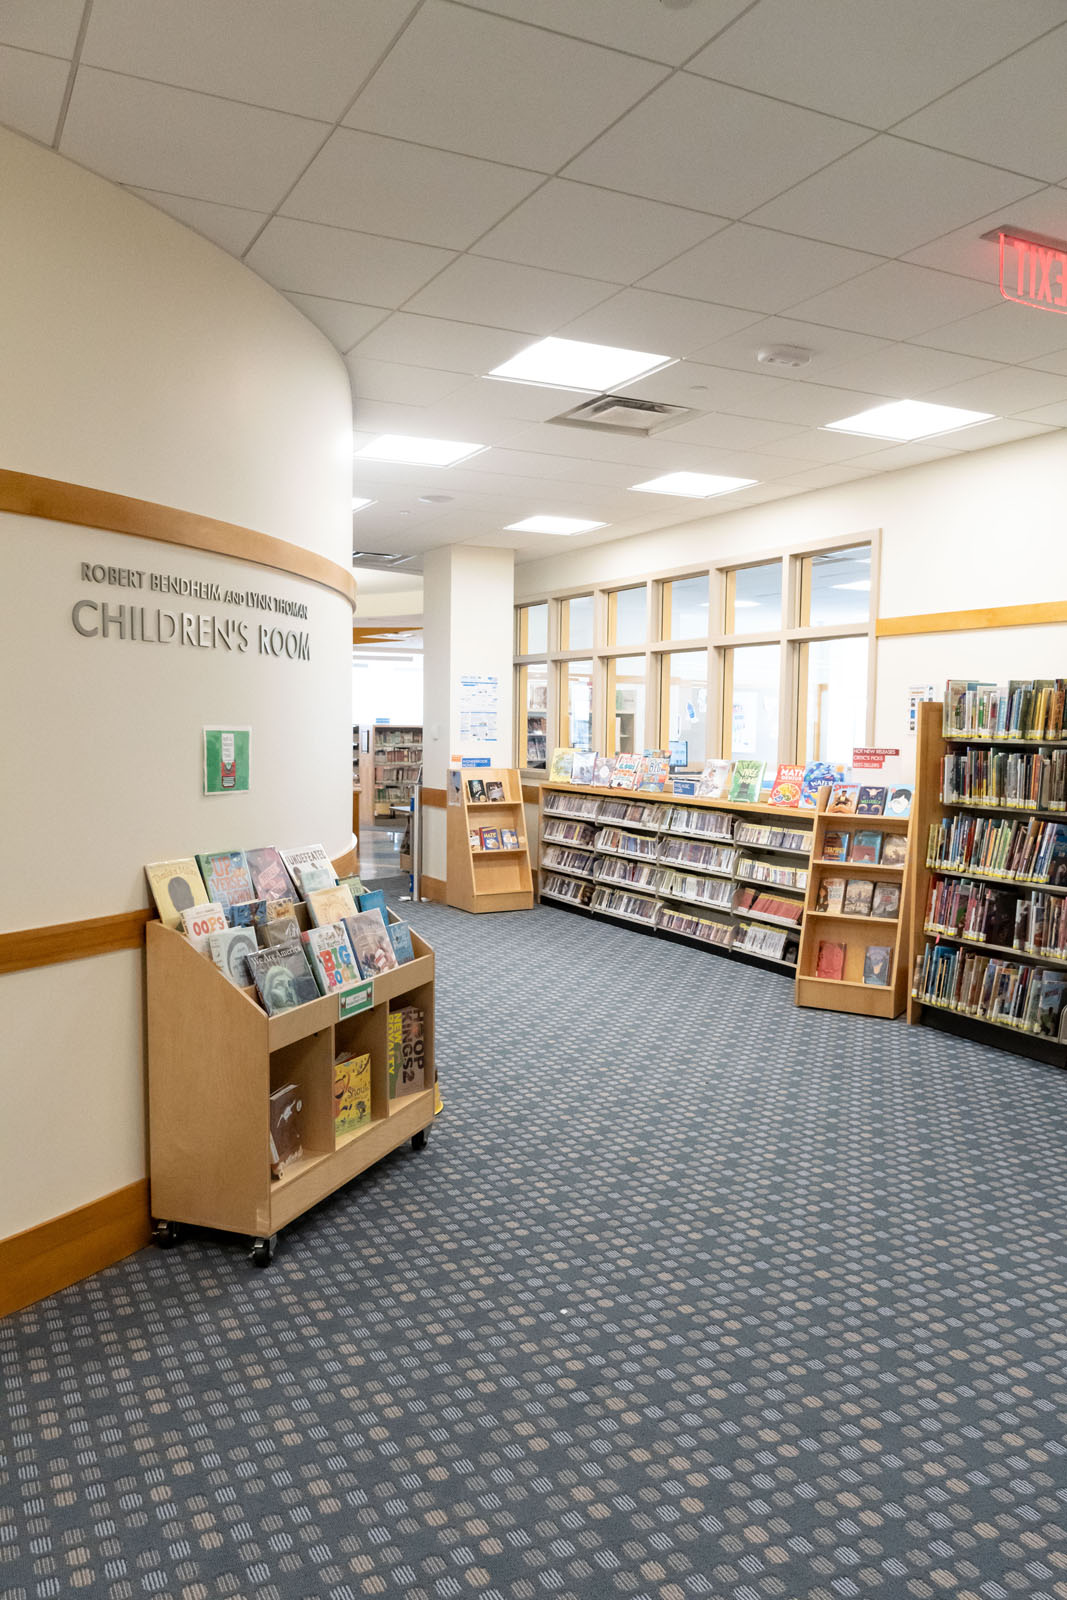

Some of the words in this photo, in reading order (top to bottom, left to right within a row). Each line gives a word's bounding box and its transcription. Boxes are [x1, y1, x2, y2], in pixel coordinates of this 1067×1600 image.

[81, 562, 145, 589] ROBERT
[150, 573, 221, 600] BENDHEIM
[224, 590, 244, 606] AND
[246, 592, 272, 612] LYNN
[273, 598, 308, 620] THOMAN
[72, 599, 248, 653] CHILDREN'S
[258, 624, 310, 661] ROOM
[780, 768, 804, 777] MATH
[211, 856, 232, 877] UP
[210, 876, 249, 892] VERSES
[193, 916, 225, 937] OOPS
[250, 955, 264, 966] We
[319, 945, 351, 973] BIG
[393, 1012, 402, 1044] NEW
[402, 1010, 413, 1070] KINGS
[402, 1070, 415, 1084] 2
